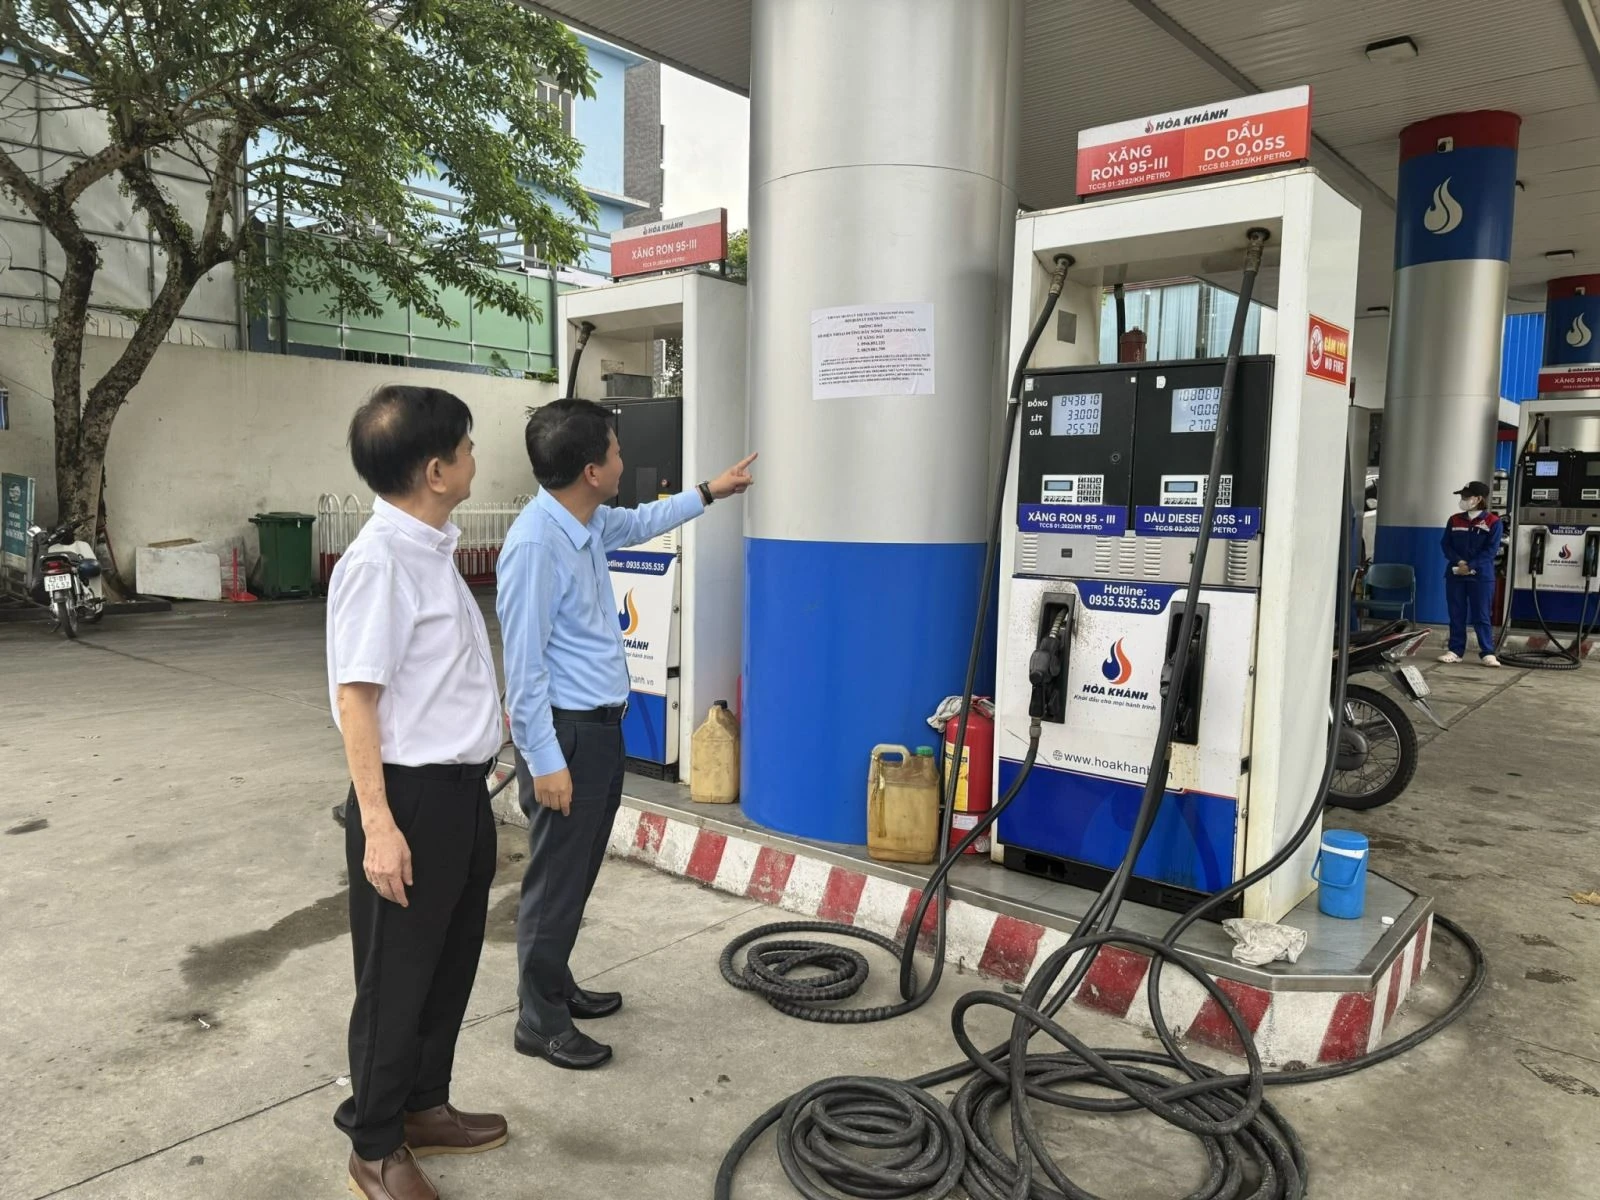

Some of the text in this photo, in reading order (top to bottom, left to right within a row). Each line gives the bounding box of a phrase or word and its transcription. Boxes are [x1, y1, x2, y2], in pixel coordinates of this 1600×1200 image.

[1184, 108, 1229, 126] KHÁNH
[1226, 121, 1264, 143] DẦU
[1107, 145, 1153, 164] XĂNG
[1204, 135, 1286, 162] DO 0,05S
[1091, 156, 1169, 182] RON 95-III
[1198, 163, 1219, 172] TCCS
[1263, 151, 1292, 162] PETRO
[1088, 182, 1107, 191] TCCS
[1146, 171, 1170, 181] PETRO
[632, 239, 697, 260] XĂNG RON 95-III
[1028, 399, 1048, 408] ĐỒNG
[1028, 511, 1057, 523] XĂNG
[1060, 513, 1080, 524] RON
[1085, 514, 1097, 524] 95
[1106, 514, 1116, 524] III
[1144, 511, 1168, 523] DẦU
[1212, 514, 1236, 526] ,05S
[1245, 514, 1251, 525] II
[607, 560, 665, 572] otline: 0935.535.535
[1104, 584, 1148, 596] Hotline:
[1089, 594, 1161, 611] 0935.535.535
[1082, 683, 1149, 701] HÒA KHÁNH
